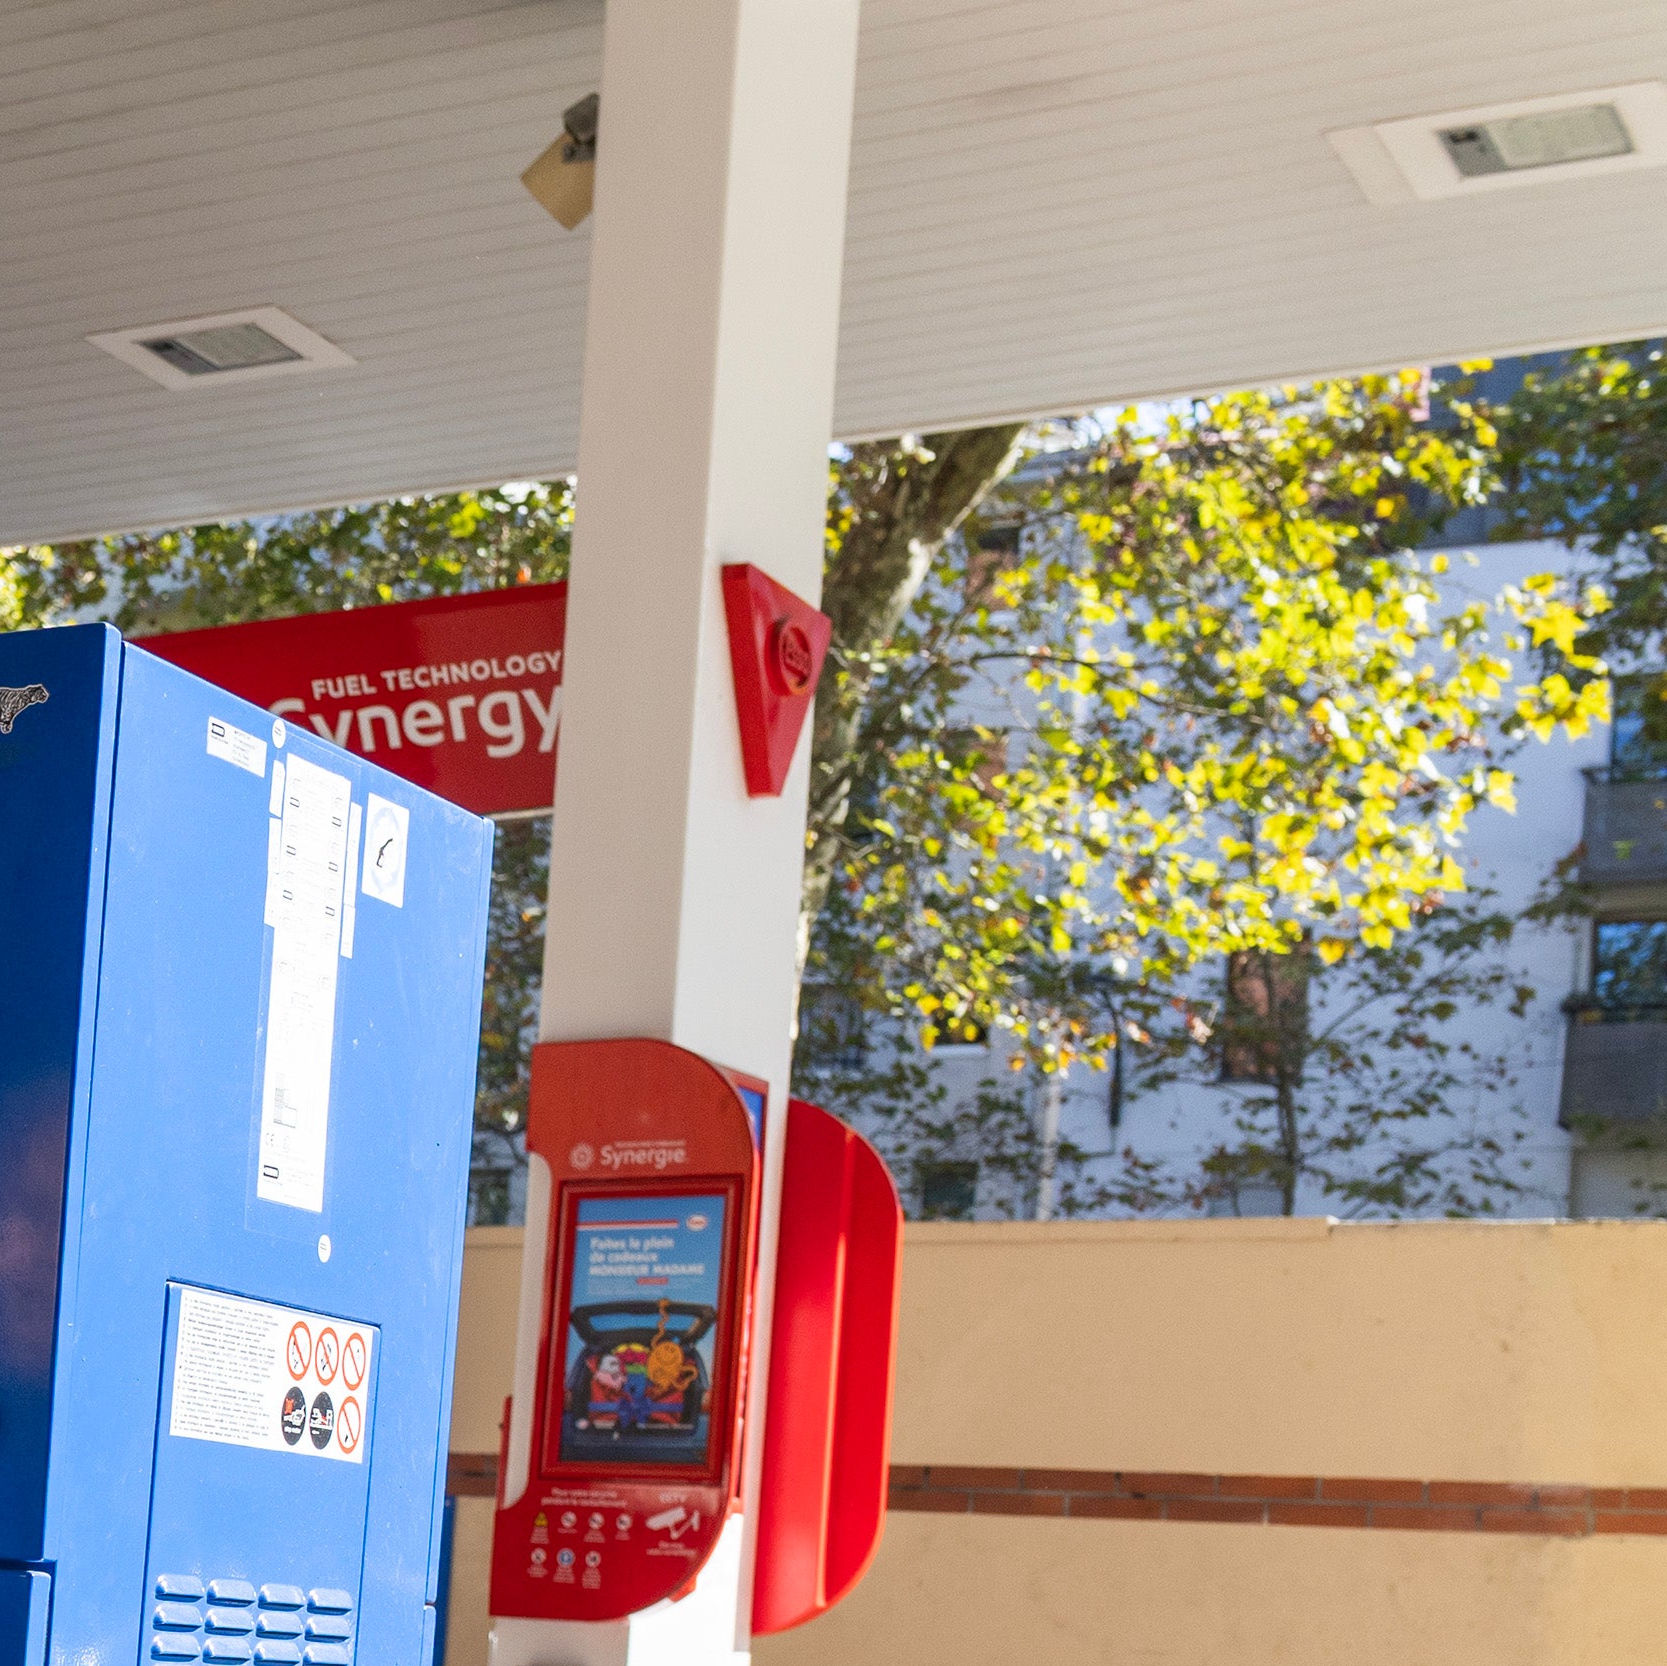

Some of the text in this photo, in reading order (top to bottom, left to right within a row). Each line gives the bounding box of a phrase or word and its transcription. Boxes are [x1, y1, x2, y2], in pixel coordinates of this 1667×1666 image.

[311, 650, 562, 701] FUEL TECHNOLOGY
[599, 1144, 686, 1171] Synergie
